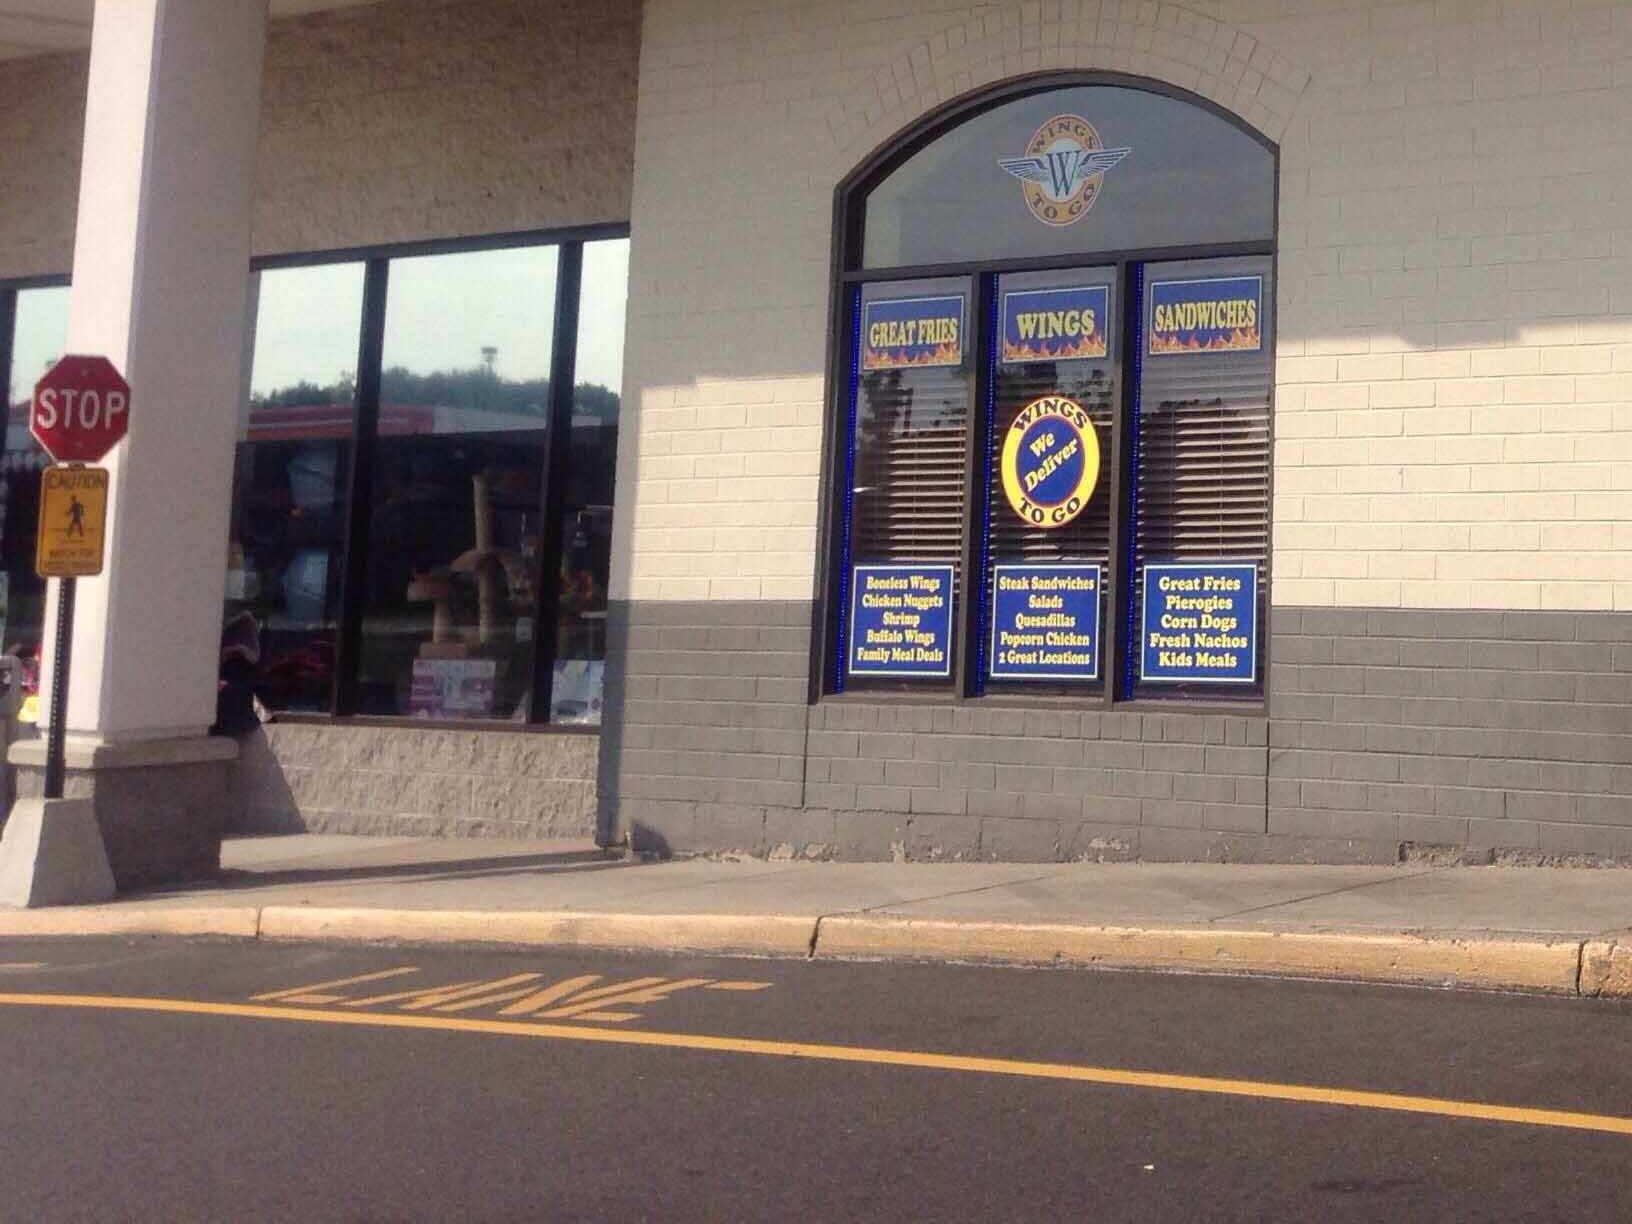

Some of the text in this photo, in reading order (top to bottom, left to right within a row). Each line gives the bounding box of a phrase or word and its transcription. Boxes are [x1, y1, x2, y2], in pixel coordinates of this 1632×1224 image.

[1032, 121, 1097, 153] WINGS
[1046, 151, 1081, 197] W
[1033, 184, 1095, 218] TO GO
[1155, 299, 1256, 332] SANDWICHES
[870, 318, 958, 347] GREAT FRIES
[1016, 309, 1094, 340] WINGS
[37, 387, 126, 430] STOP
[1014, 399, 1087, 430] WINGS
[1029, 432, 1055, 457] We
[1024, 438, 1078, 492] Deliver
[46, 473, 104, 489] CAUTION
[1019, 497, 1080, 523] TO GO
[867, 576, 940, 592] Boneless Wings
[999, 577, 1094, 590] Steak Sandwiches
[1159, 577, 1240, 590] Great Fries
[862, 594, 943, 610] Chicken Nuggets
[1029, 595, 1063, 608] Salads
[1166, 595, 1232, 613] Pierogies
[883, 612, 920, 628] Shrimp
[1016, 613, 1075, 629] Quesadillas
[1161, 615, 1236, 631] Corn Dogs
[867, 630, 935, 646] Buffalo Wings
[1000, 632, 1089, 648] Popcorn Chicken
[1150, 633, 1247, 648] Fresh Nachos
[857, 648, 943, 663] Family Meal Deals
[999, 650, 1090, 664] 2 Great Locations
[1159, 652, 1237, 667] Kids Meals
[250, 966, 773, 1022] LANE
